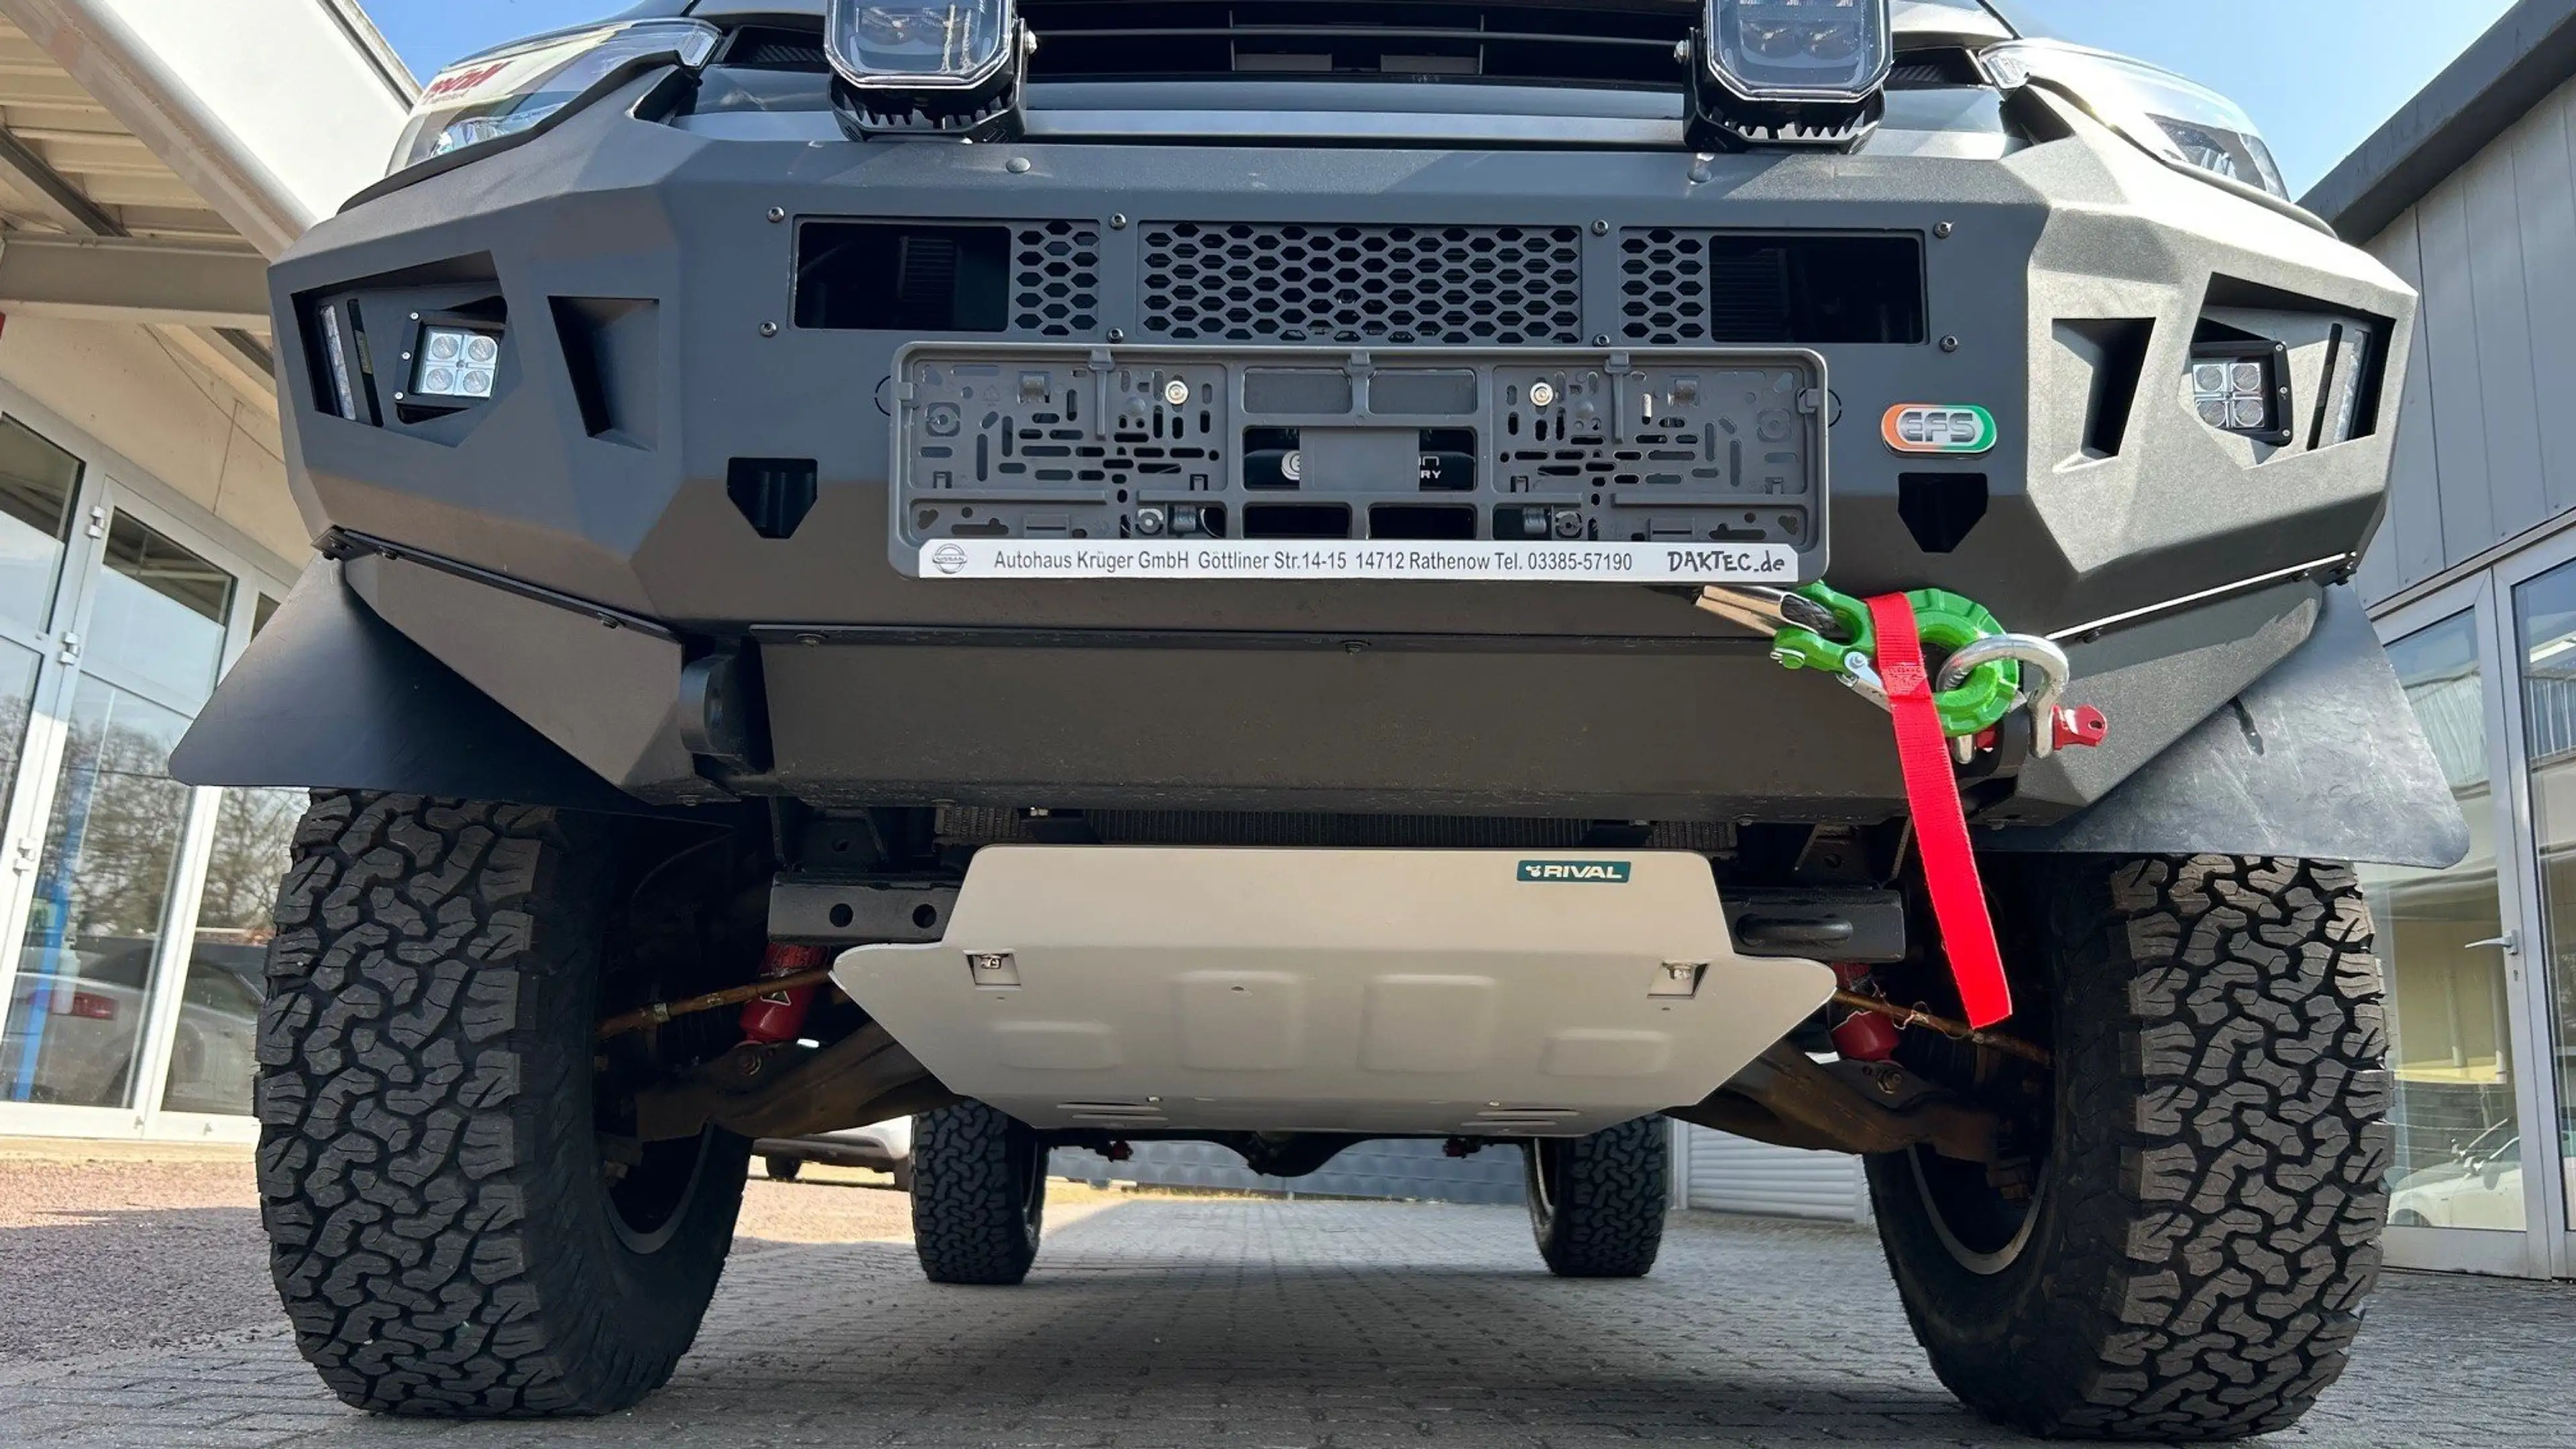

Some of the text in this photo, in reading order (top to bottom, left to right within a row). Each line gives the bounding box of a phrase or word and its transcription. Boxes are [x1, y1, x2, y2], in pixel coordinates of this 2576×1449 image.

[1899, 412, 1975, 443] EFS
[994, 551, 1072, 568] Autohaus
[1077, 551, 1134, 574] Krüger
[1138, 550, 1189, 569] GmbH
[1198, 551, 1270, 570] Göttliner
[1356, 551, 1404, 570] 14712
[1409, 551, 1491, 570] Rathenow
[1494, 552, 1523, 570] Tel.
[1527, 551, 1632, 571] 03385-57190
[1667, 549, 1785, 573] DAKTEC.de
[1544, 865, 1622, 878] RIVAL
